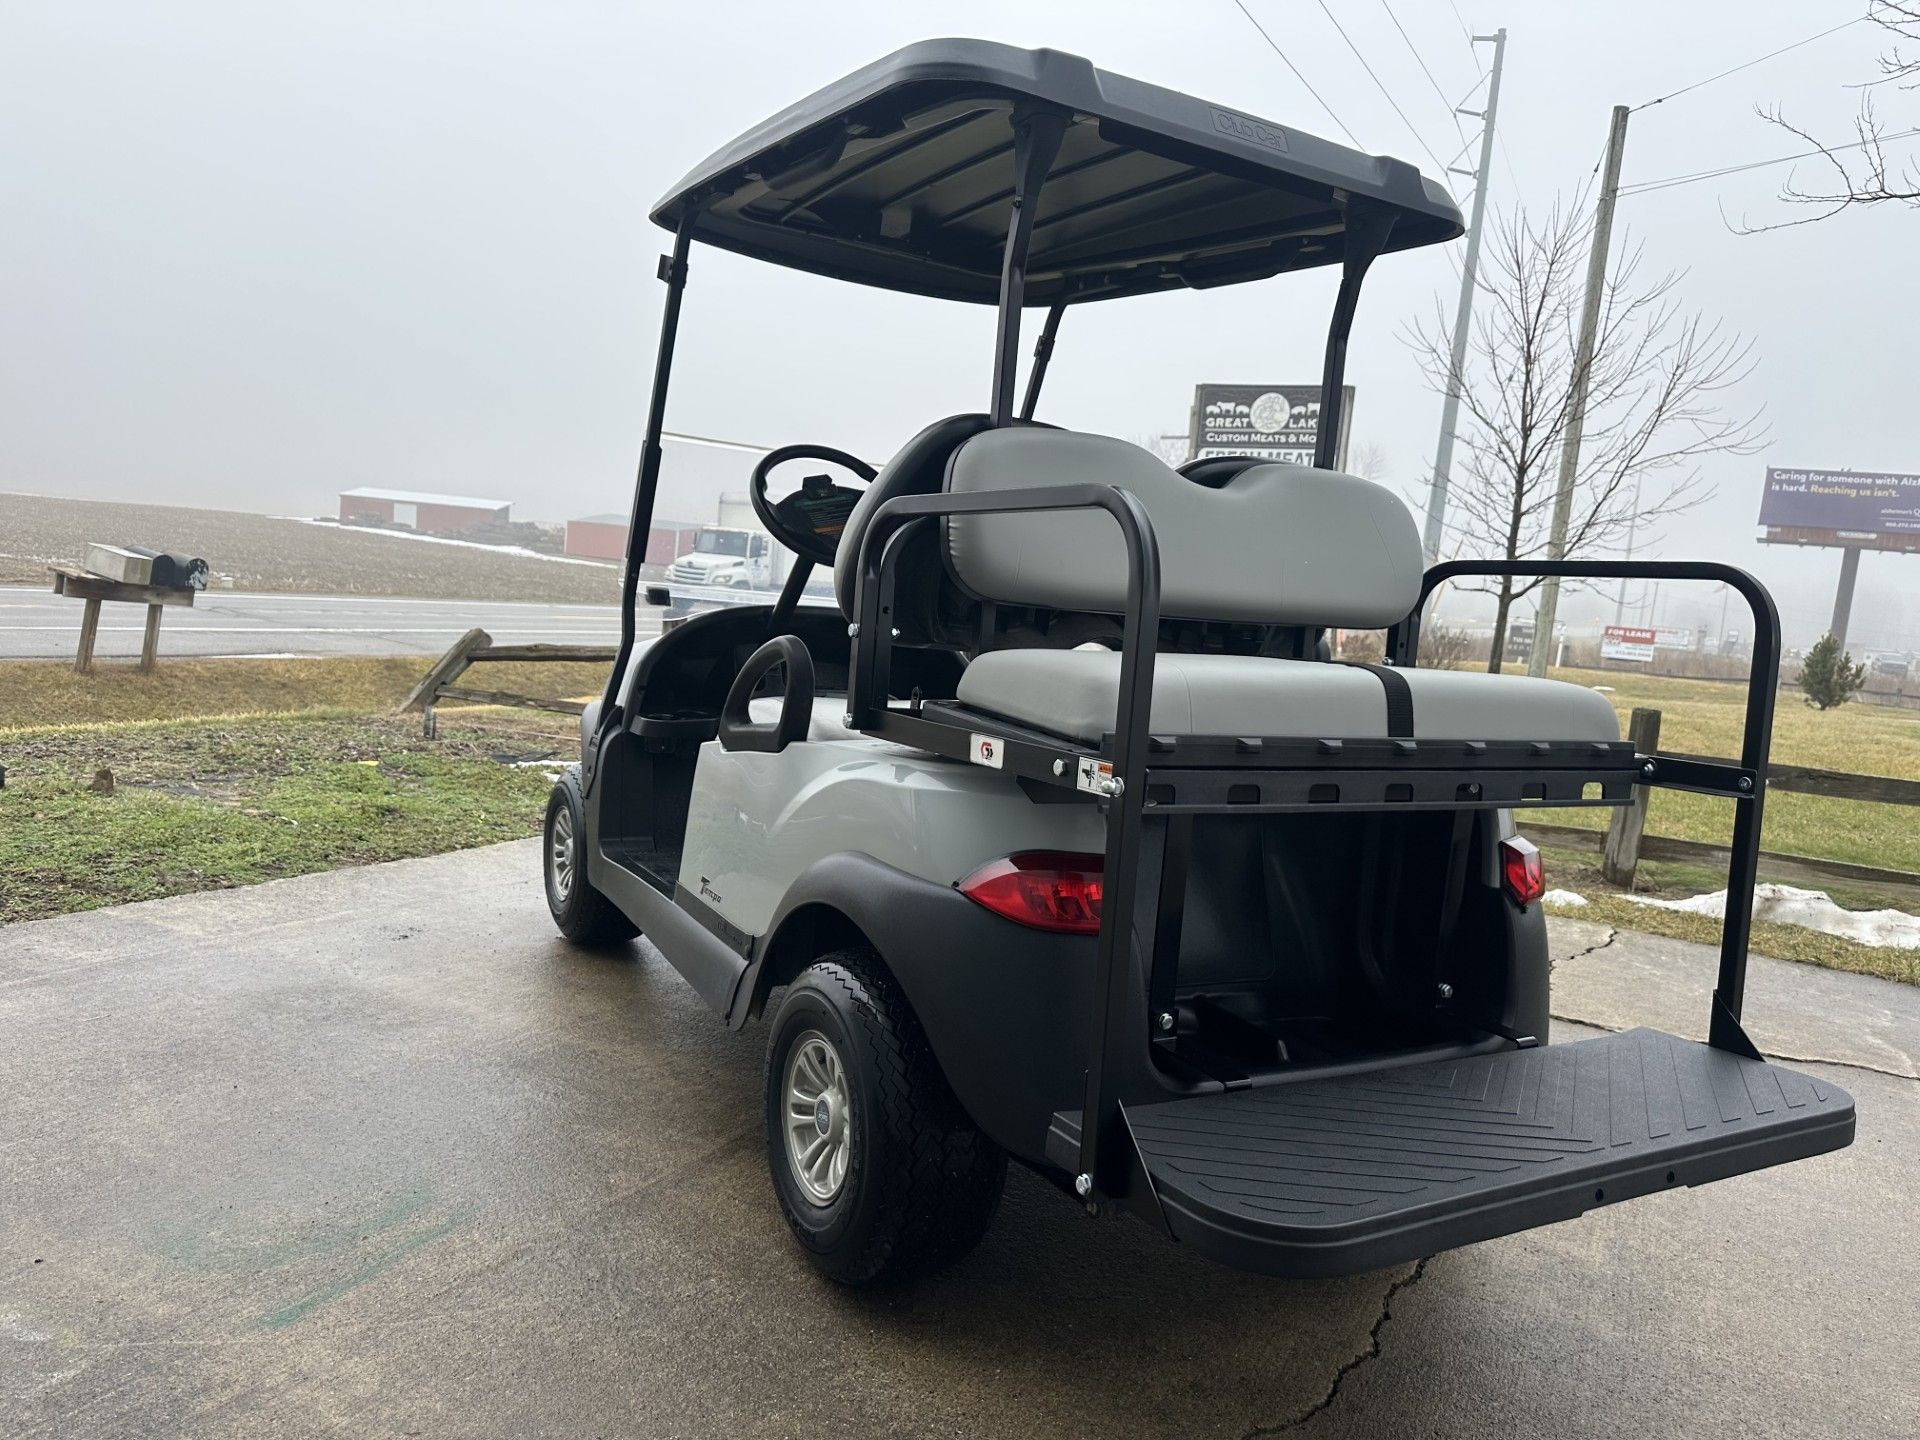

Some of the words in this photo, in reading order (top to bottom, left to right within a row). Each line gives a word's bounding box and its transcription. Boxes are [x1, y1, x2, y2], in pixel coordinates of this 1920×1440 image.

[1206, 418, 1249, 428] GREAT
[1289, 419, 1318, 428] LAK
[1288, 434, 1296, 443] &
[1299, 434, 1317, 443] MO
[1773, 471, 1806, 482] Caring
[1809, 472, 1824, 481] for
[1827, 476, 1872, 484] someone
[1875, 476, 1898, 485] with
[1772, 482, 1779, 491] is
[1783, 484, 1808, 492] hard.
[1810, 485, 1857, 497] Reaching
[1874, 488, 1900, 497] isn't.
[1608, 629, 1624, 637] FOR
[1626, 630, 1652, 639] LEASE
[701, 876, 722, 903] Tempo
